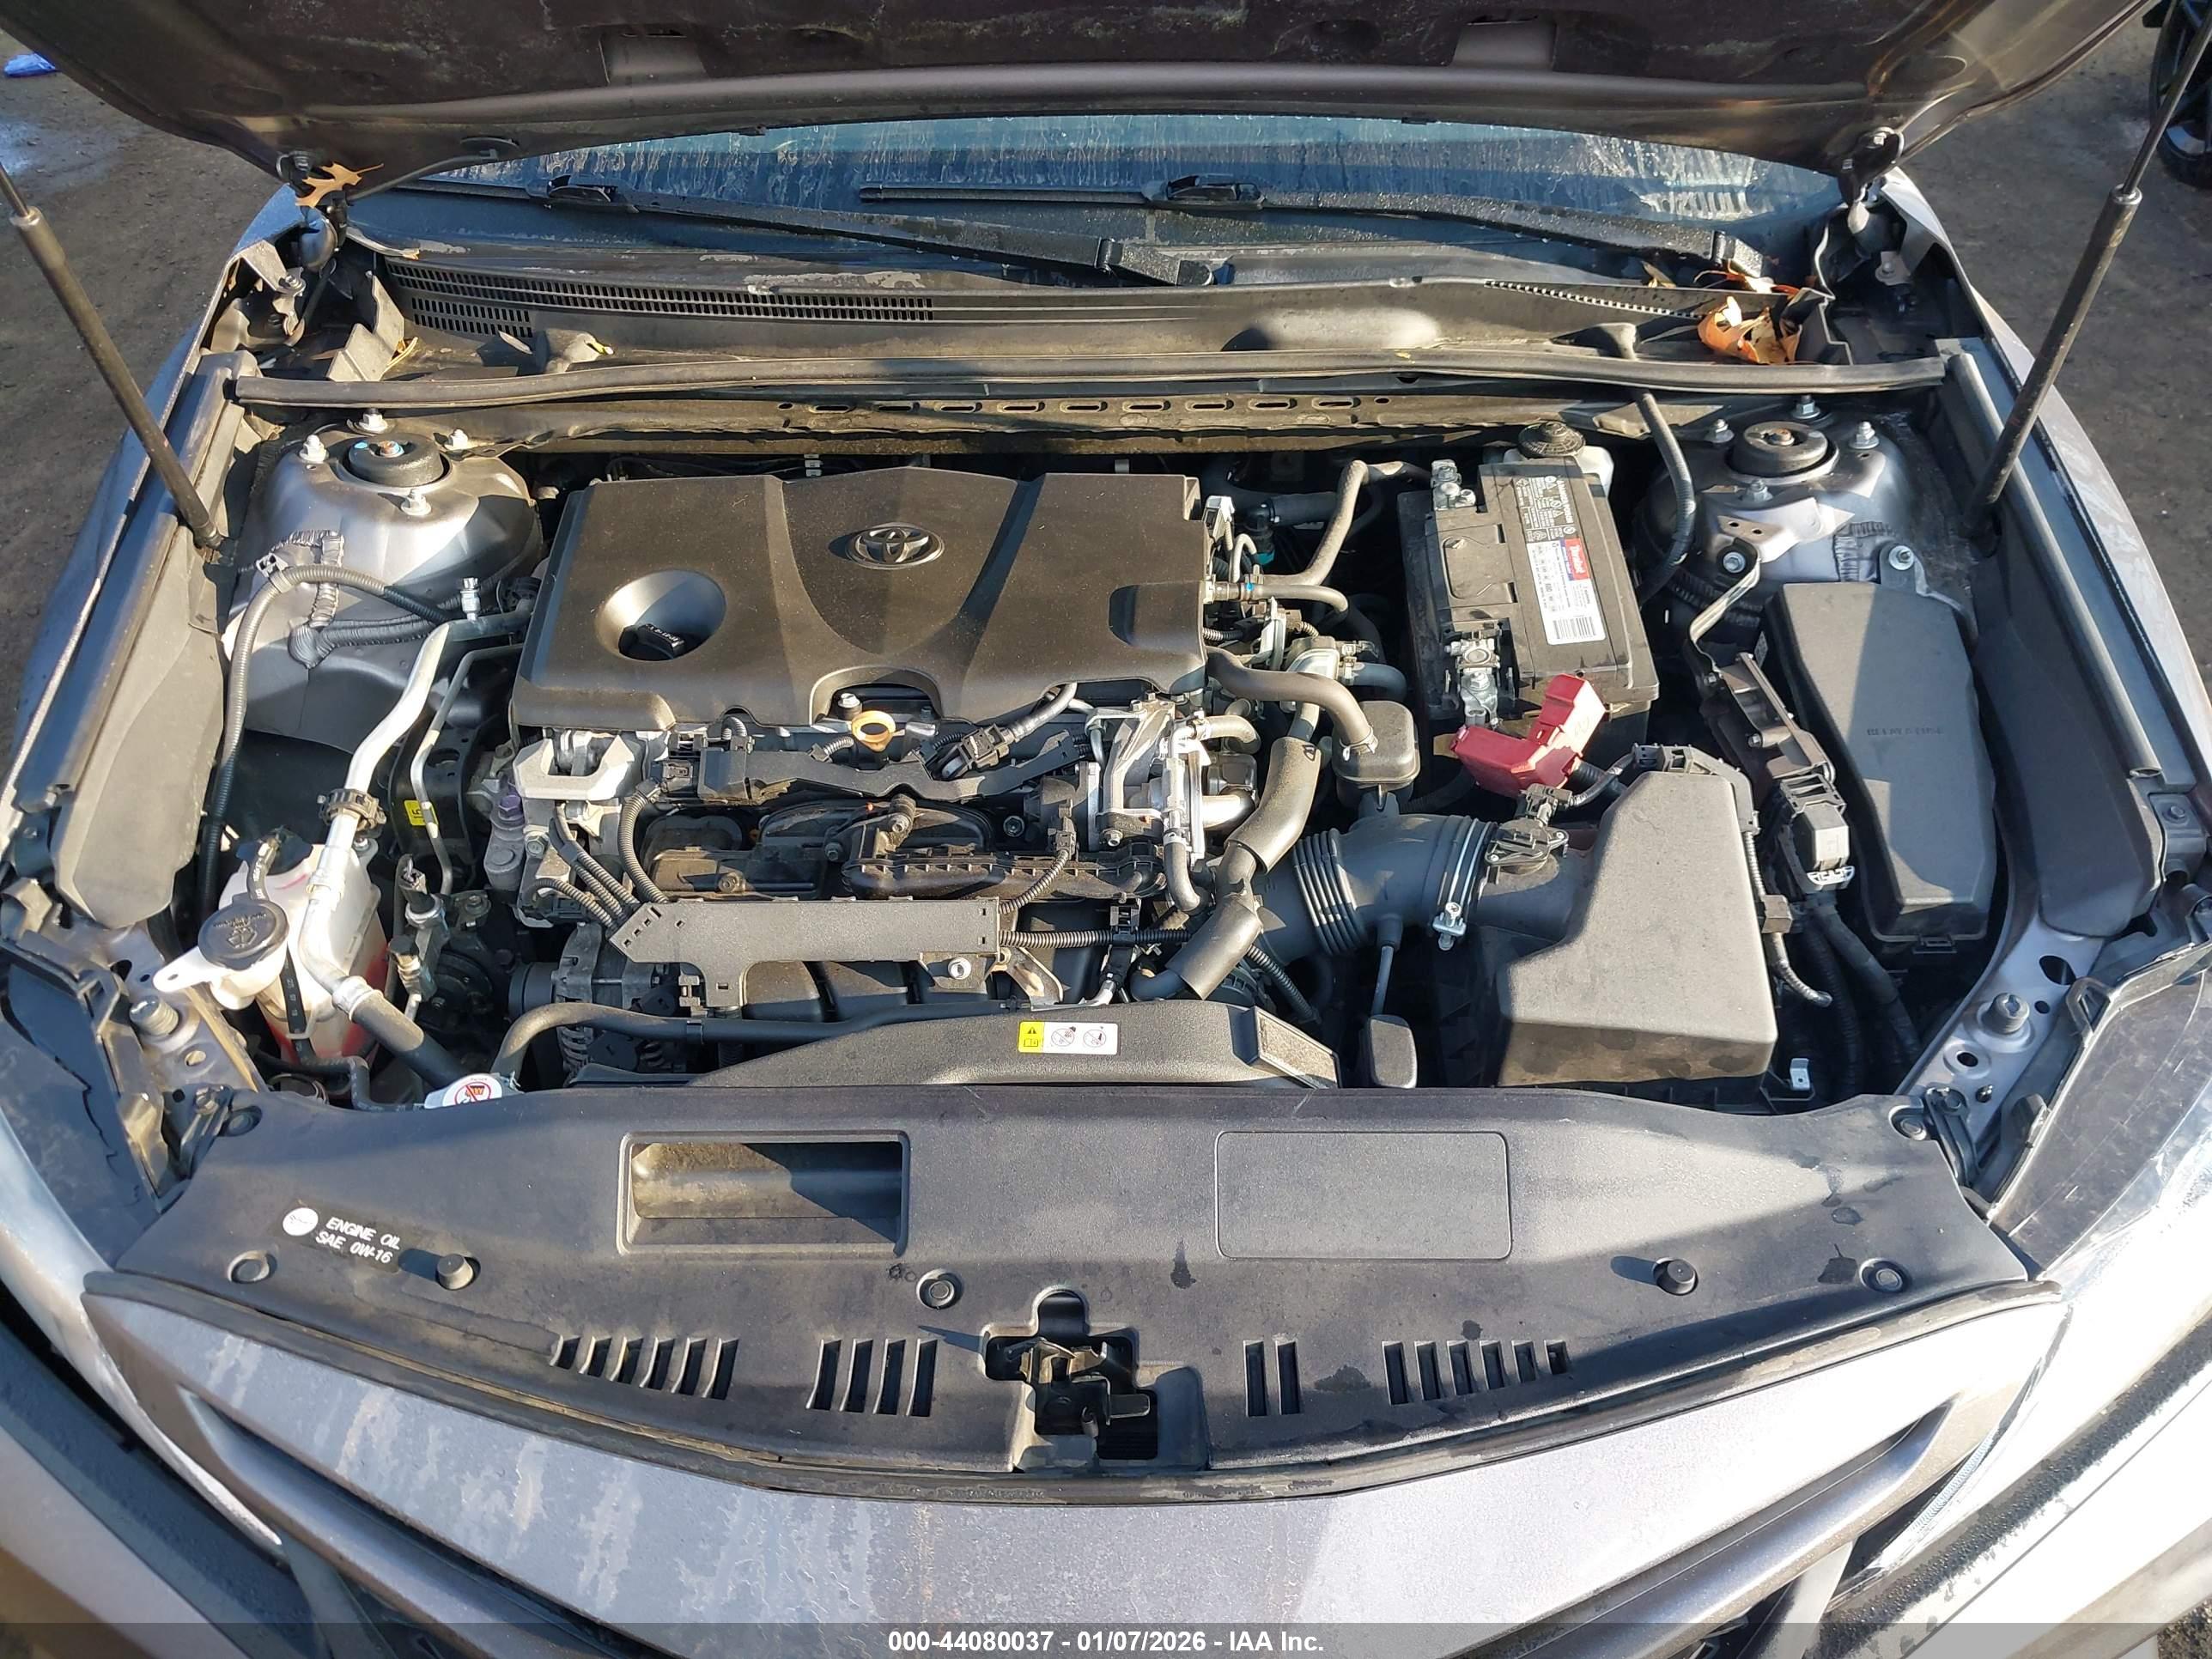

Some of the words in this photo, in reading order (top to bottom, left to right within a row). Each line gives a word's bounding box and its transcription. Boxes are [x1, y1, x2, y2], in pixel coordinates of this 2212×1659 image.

[315, 1231, 346, 1249] SAE
[349, 1242, 393, 1263] 0W-16
[325, 1217, 377, 1242] ENGINE
[380, 1233, 401, 1250] OIL
